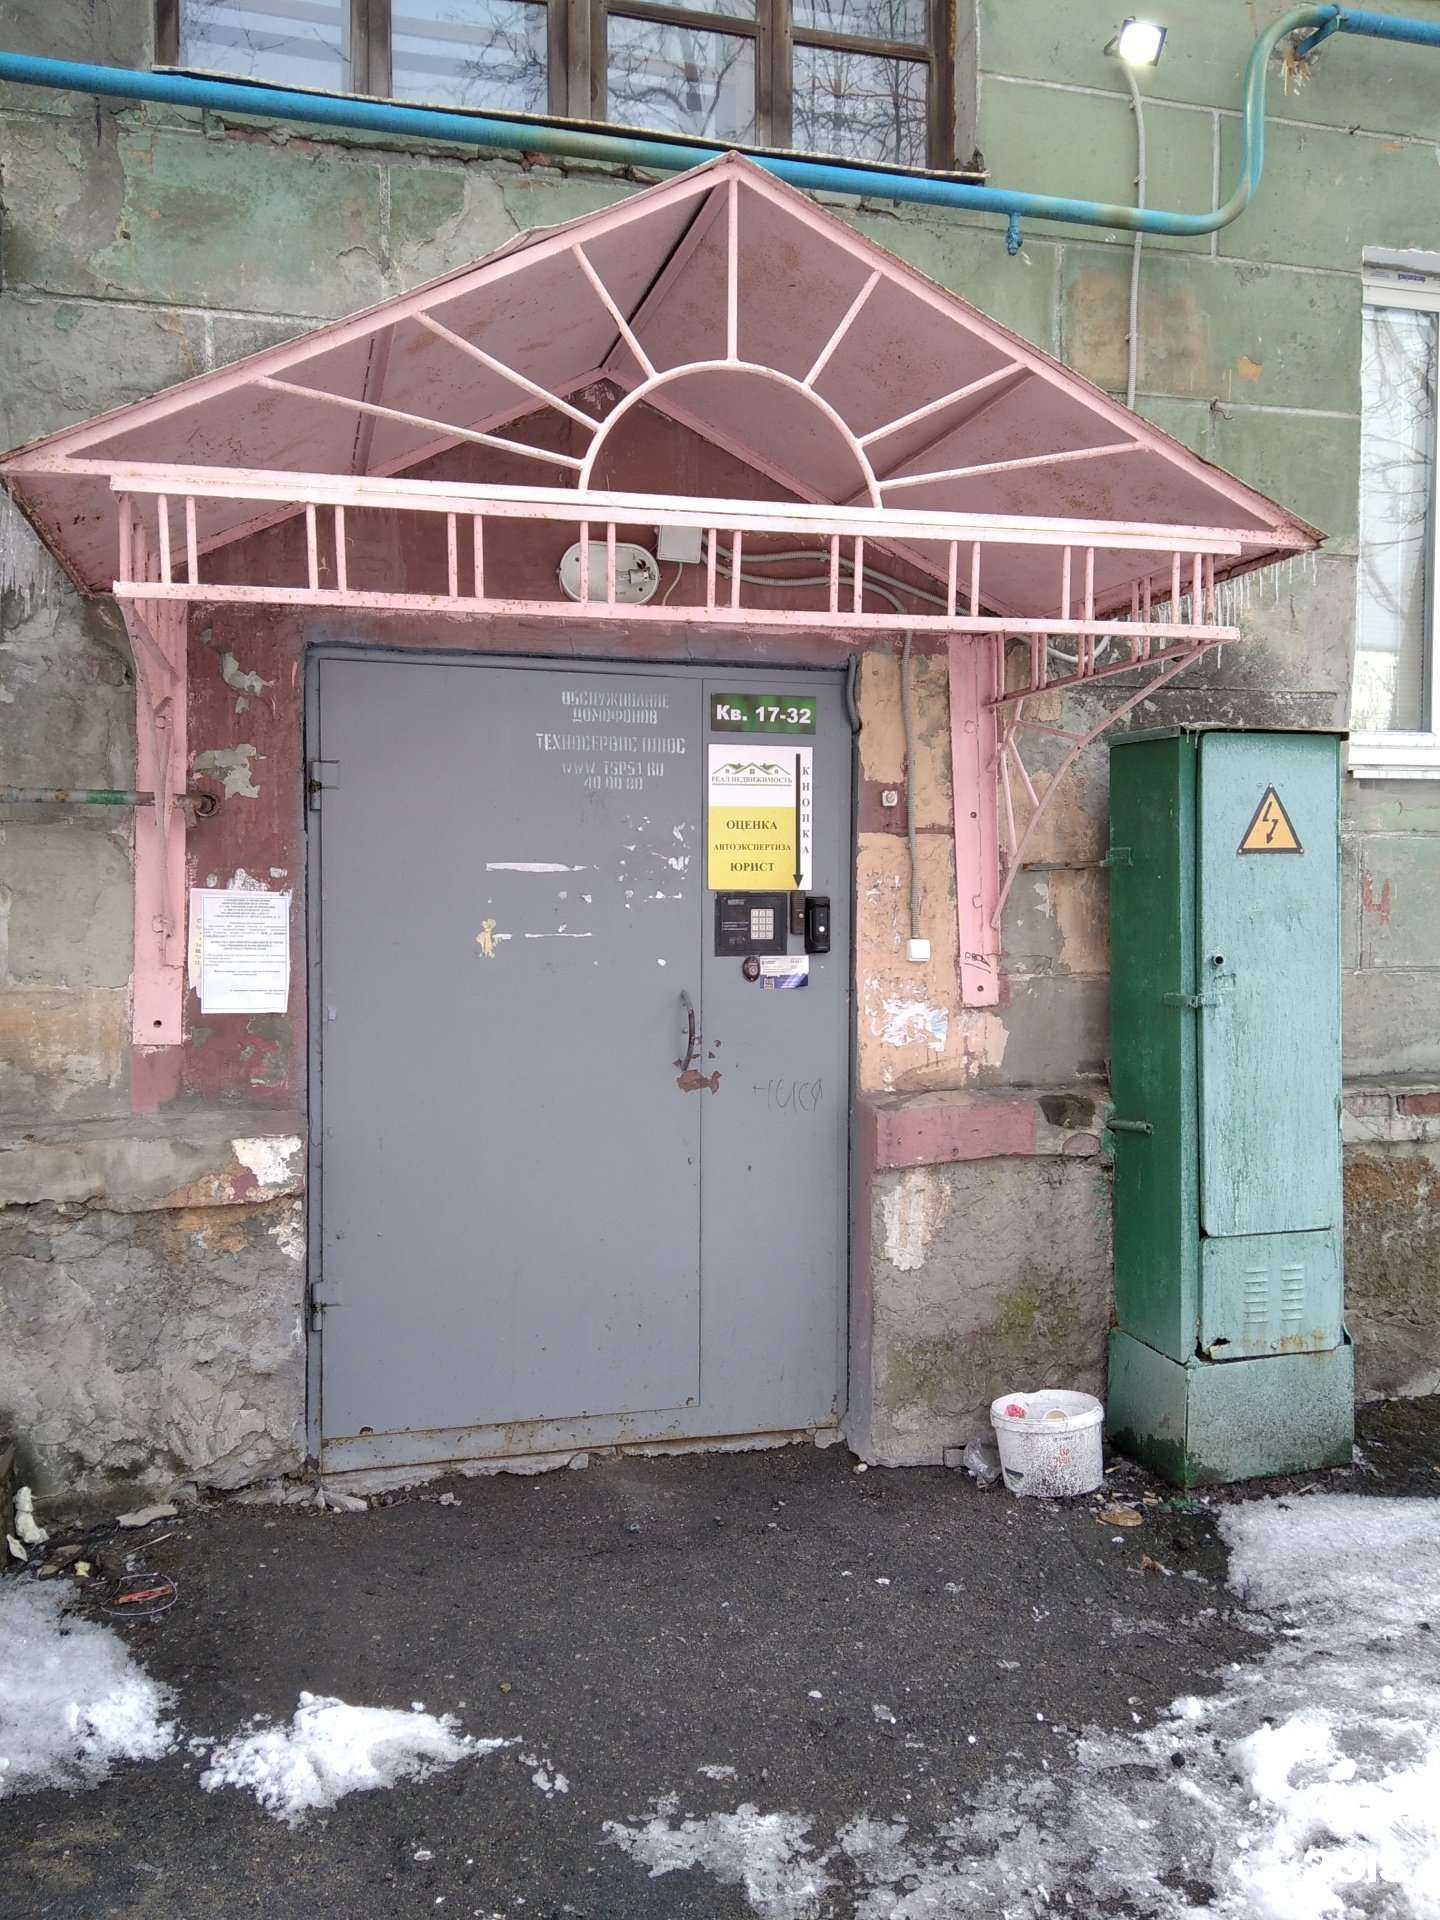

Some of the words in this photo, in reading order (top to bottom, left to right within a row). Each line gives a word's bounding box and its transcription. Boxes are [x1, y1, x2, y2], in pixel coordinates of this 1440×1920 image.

[561, 691, 669, 708] ОБСЛУЖИВАНИЕ
[572, 707, 657, 724] ДОМОФОНОВ
[716, 704, 747, 721] Кв.
[755, 706, 811, 724] 17-32
[536, 733, 637, 752] ТЕХНОСЕРВИС
[732, 776, 792, 784] НЕДВИЖИМОСТЬ
[802, 766, 811, 855] КНОПКА
[726, 820, 778, 831] ОЦЕНКА
[714, 843, 792, 852] АВТОЭКСПЕРТИЗА
[730, 862, 775, 872] ЮРИСТ
